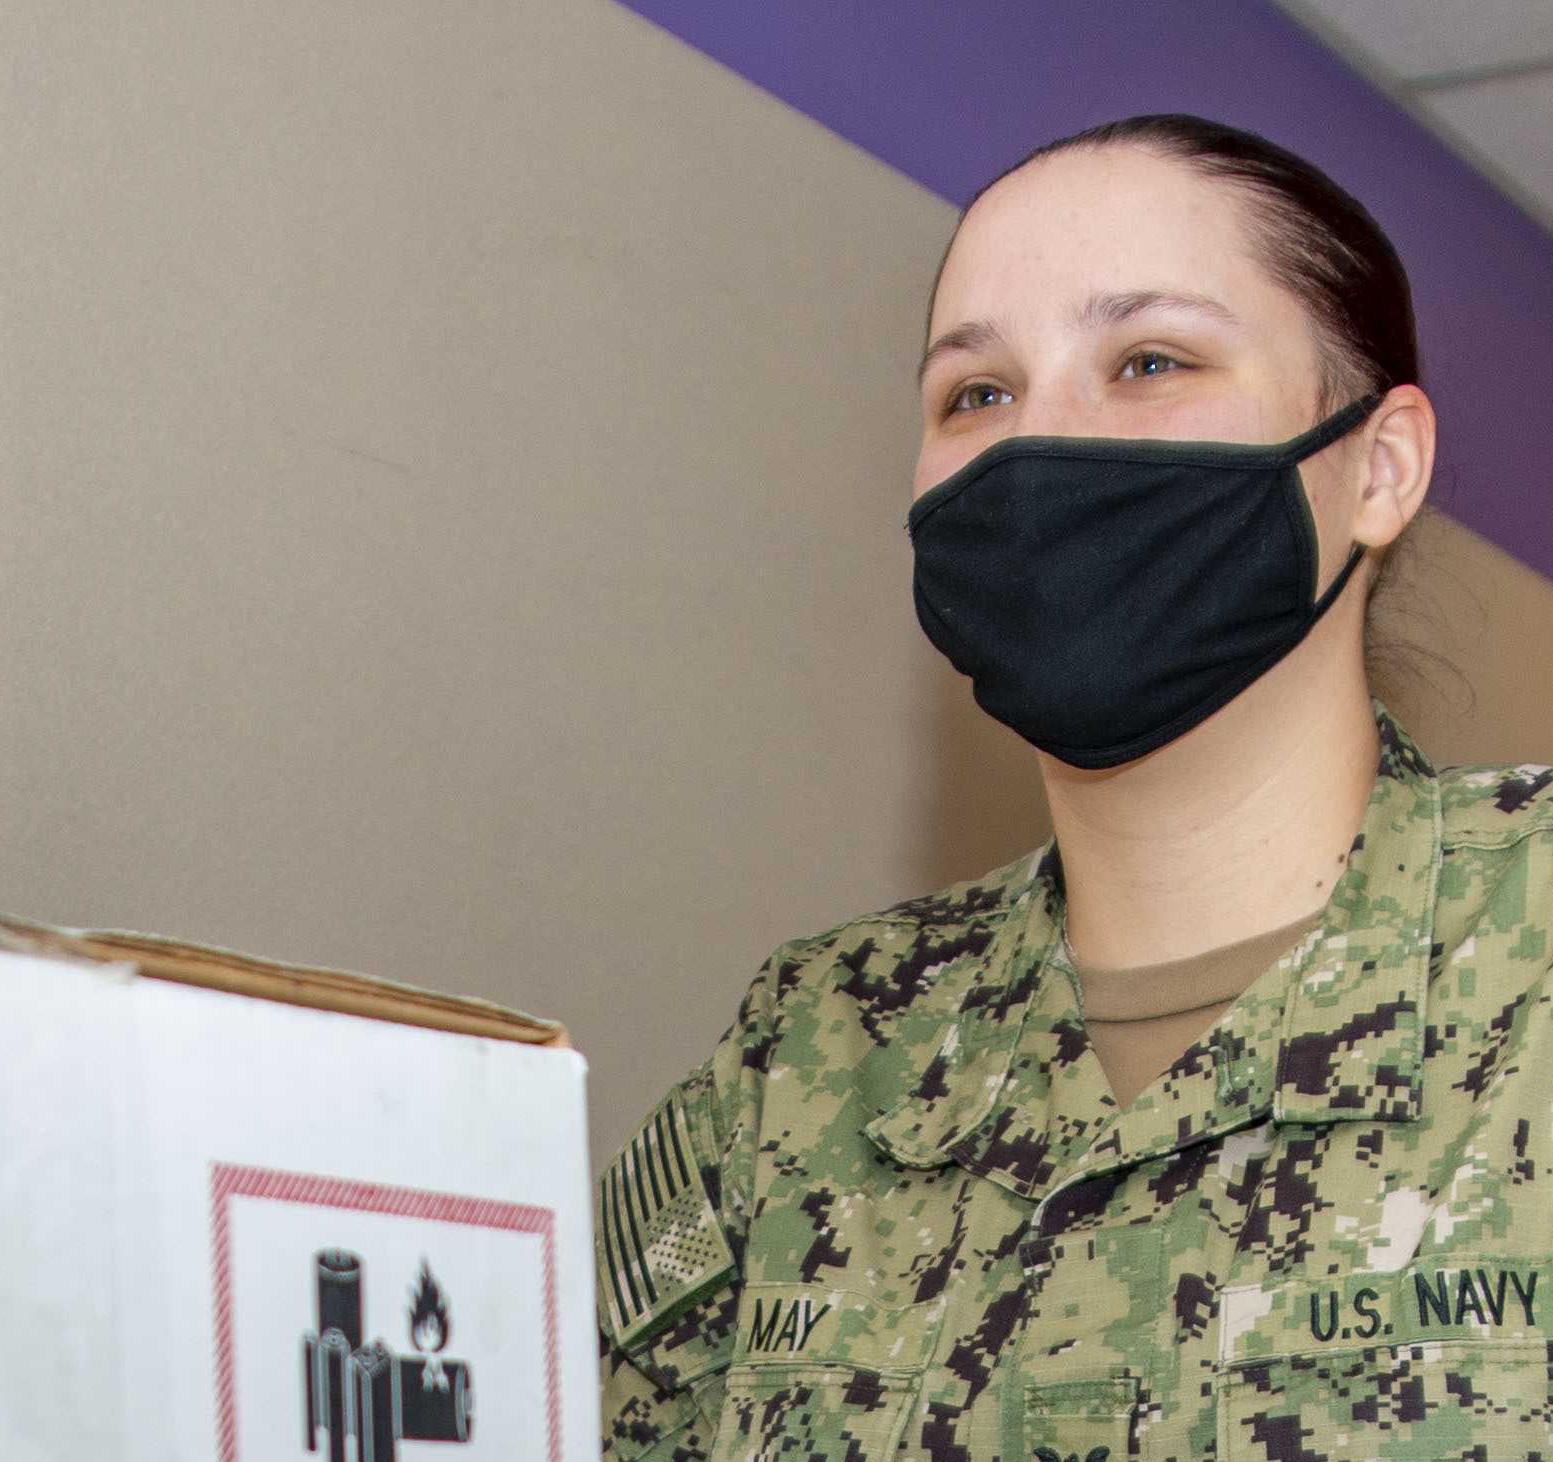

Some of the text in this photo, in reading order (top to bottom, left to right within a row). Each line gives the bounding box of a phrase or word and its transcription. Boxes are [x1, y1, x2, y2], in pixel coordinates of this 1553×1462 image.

[747, 1298, 830, 1352] MAY
[1309, 1268, 1539, 1342] U.S. NAVY
